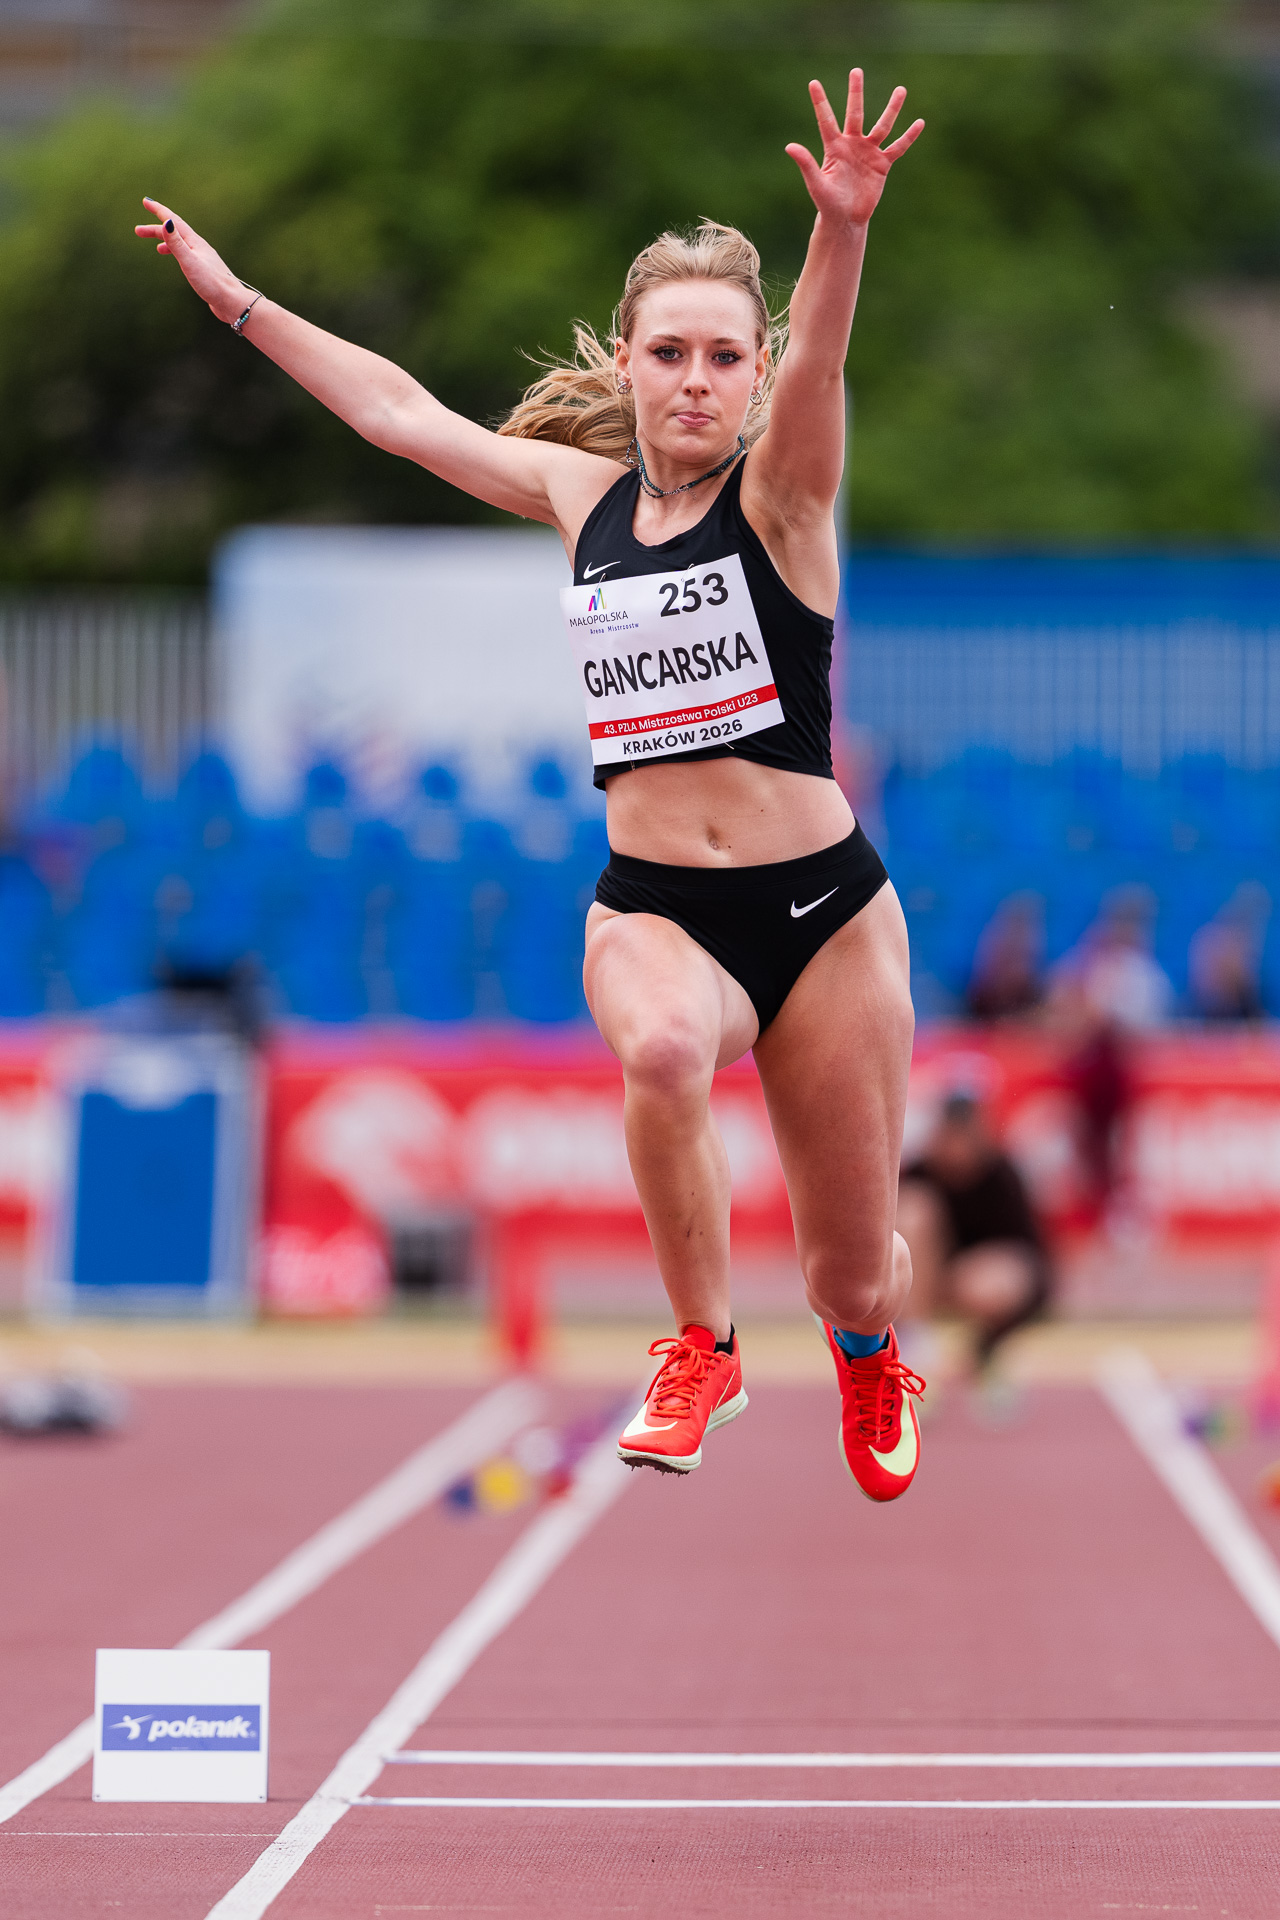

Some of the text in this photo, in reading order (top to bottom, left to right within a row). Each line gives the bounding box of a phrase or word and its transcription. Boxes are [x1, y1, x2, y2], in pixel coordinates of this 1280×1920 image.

[659, 572, 729, 617] 253
[569, 610, 629, 627] MAŁOPOLSKA
[607, 622, 639, 633] Mistrzostw
[584, 631, 759, 698] GANCARSKA
[604, 693, 759, 735] 43. PZLA Mistrzostwa Polski U23
[623, 719, 743, 755] KRAKÓW 2026
[147, 1715, 252, 1742] polanik
